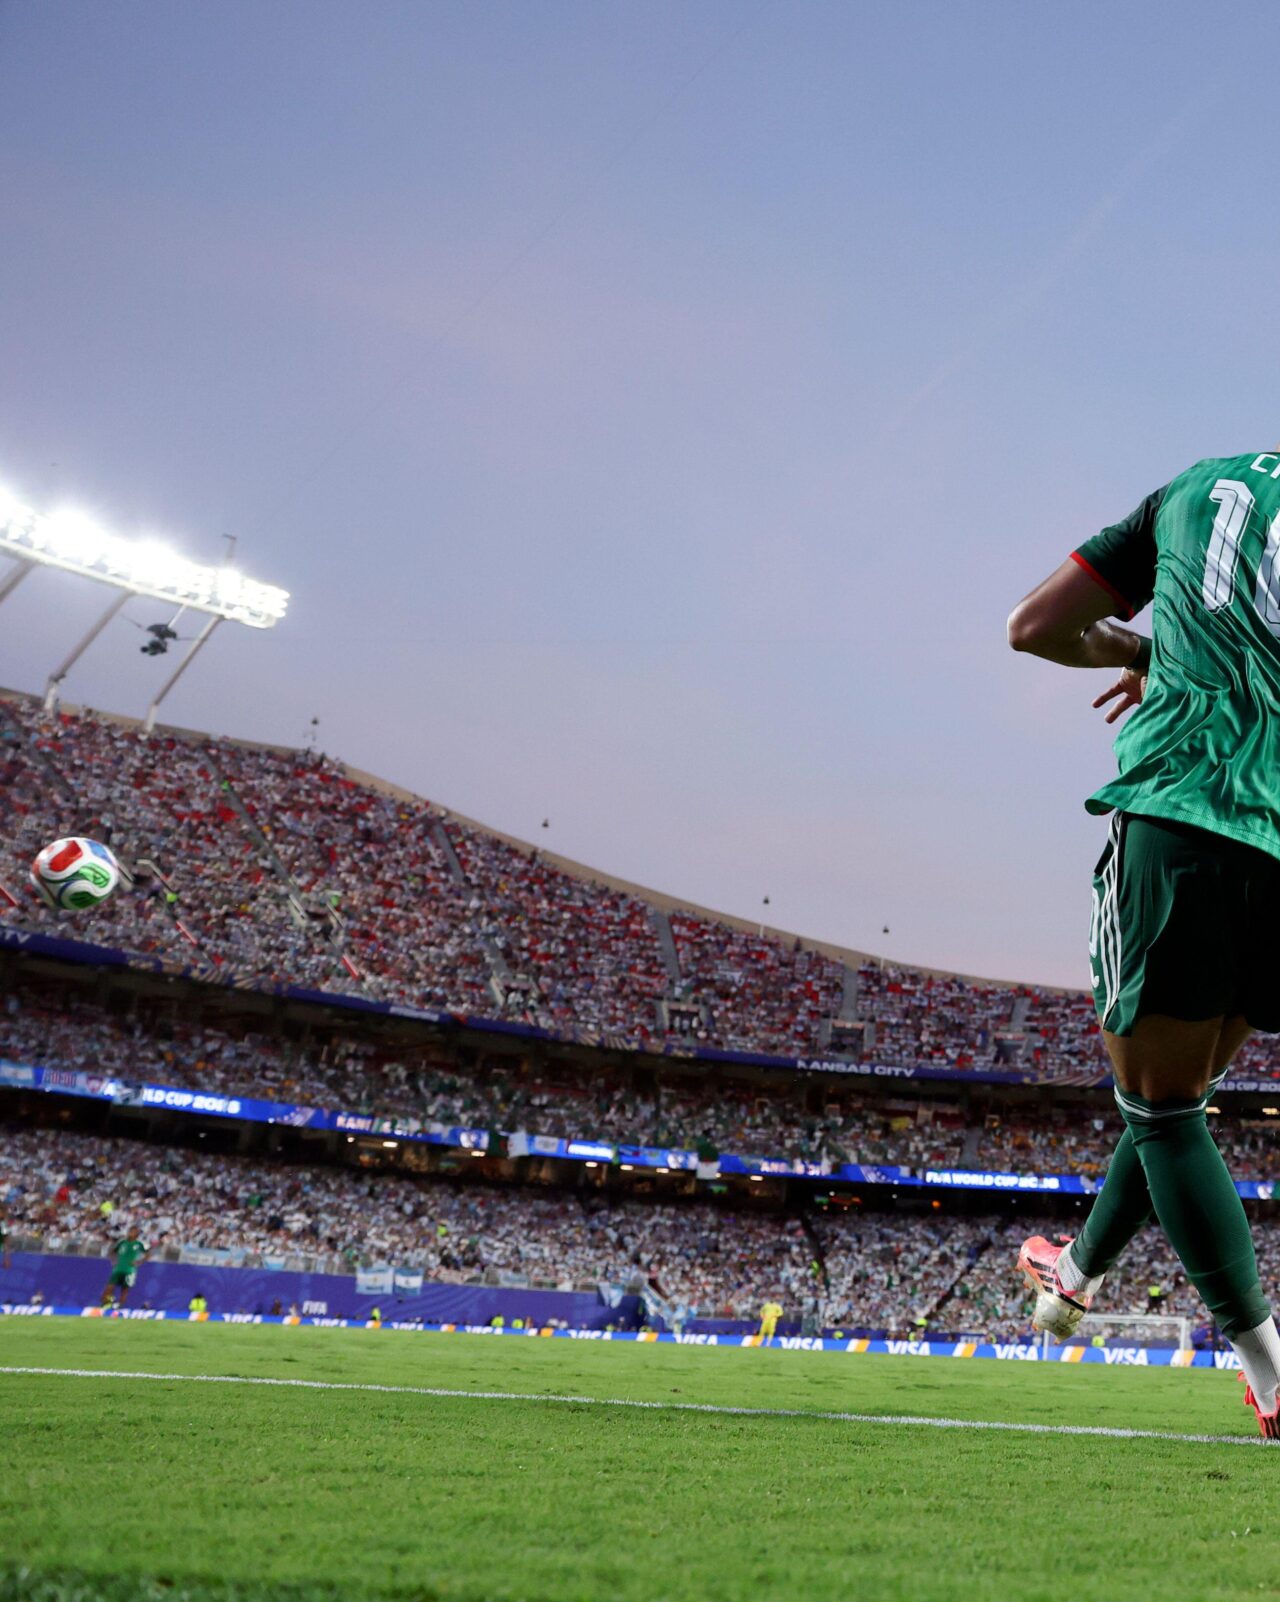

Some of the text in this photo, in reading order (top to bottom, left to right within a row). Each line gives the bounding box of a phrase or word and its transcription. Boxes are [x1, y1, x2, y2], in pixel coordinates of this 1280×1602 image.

[797, 1060, 915, 1078] KANSAS CITY
[951, 1173, 994, 1187] WORLD
[994, 1175, 1019, 1188] CUP
[302, 1300, 328, 1315] FIFA
[778, 1336, 824, 1351] VISA
[885, 1340, 931, 1356] VISA
[991, 1343, 1039, 1361] VISA
[1100, 1347, 1149, 1366] VISA
[1213, 1350, 1244, 1370] VIS
